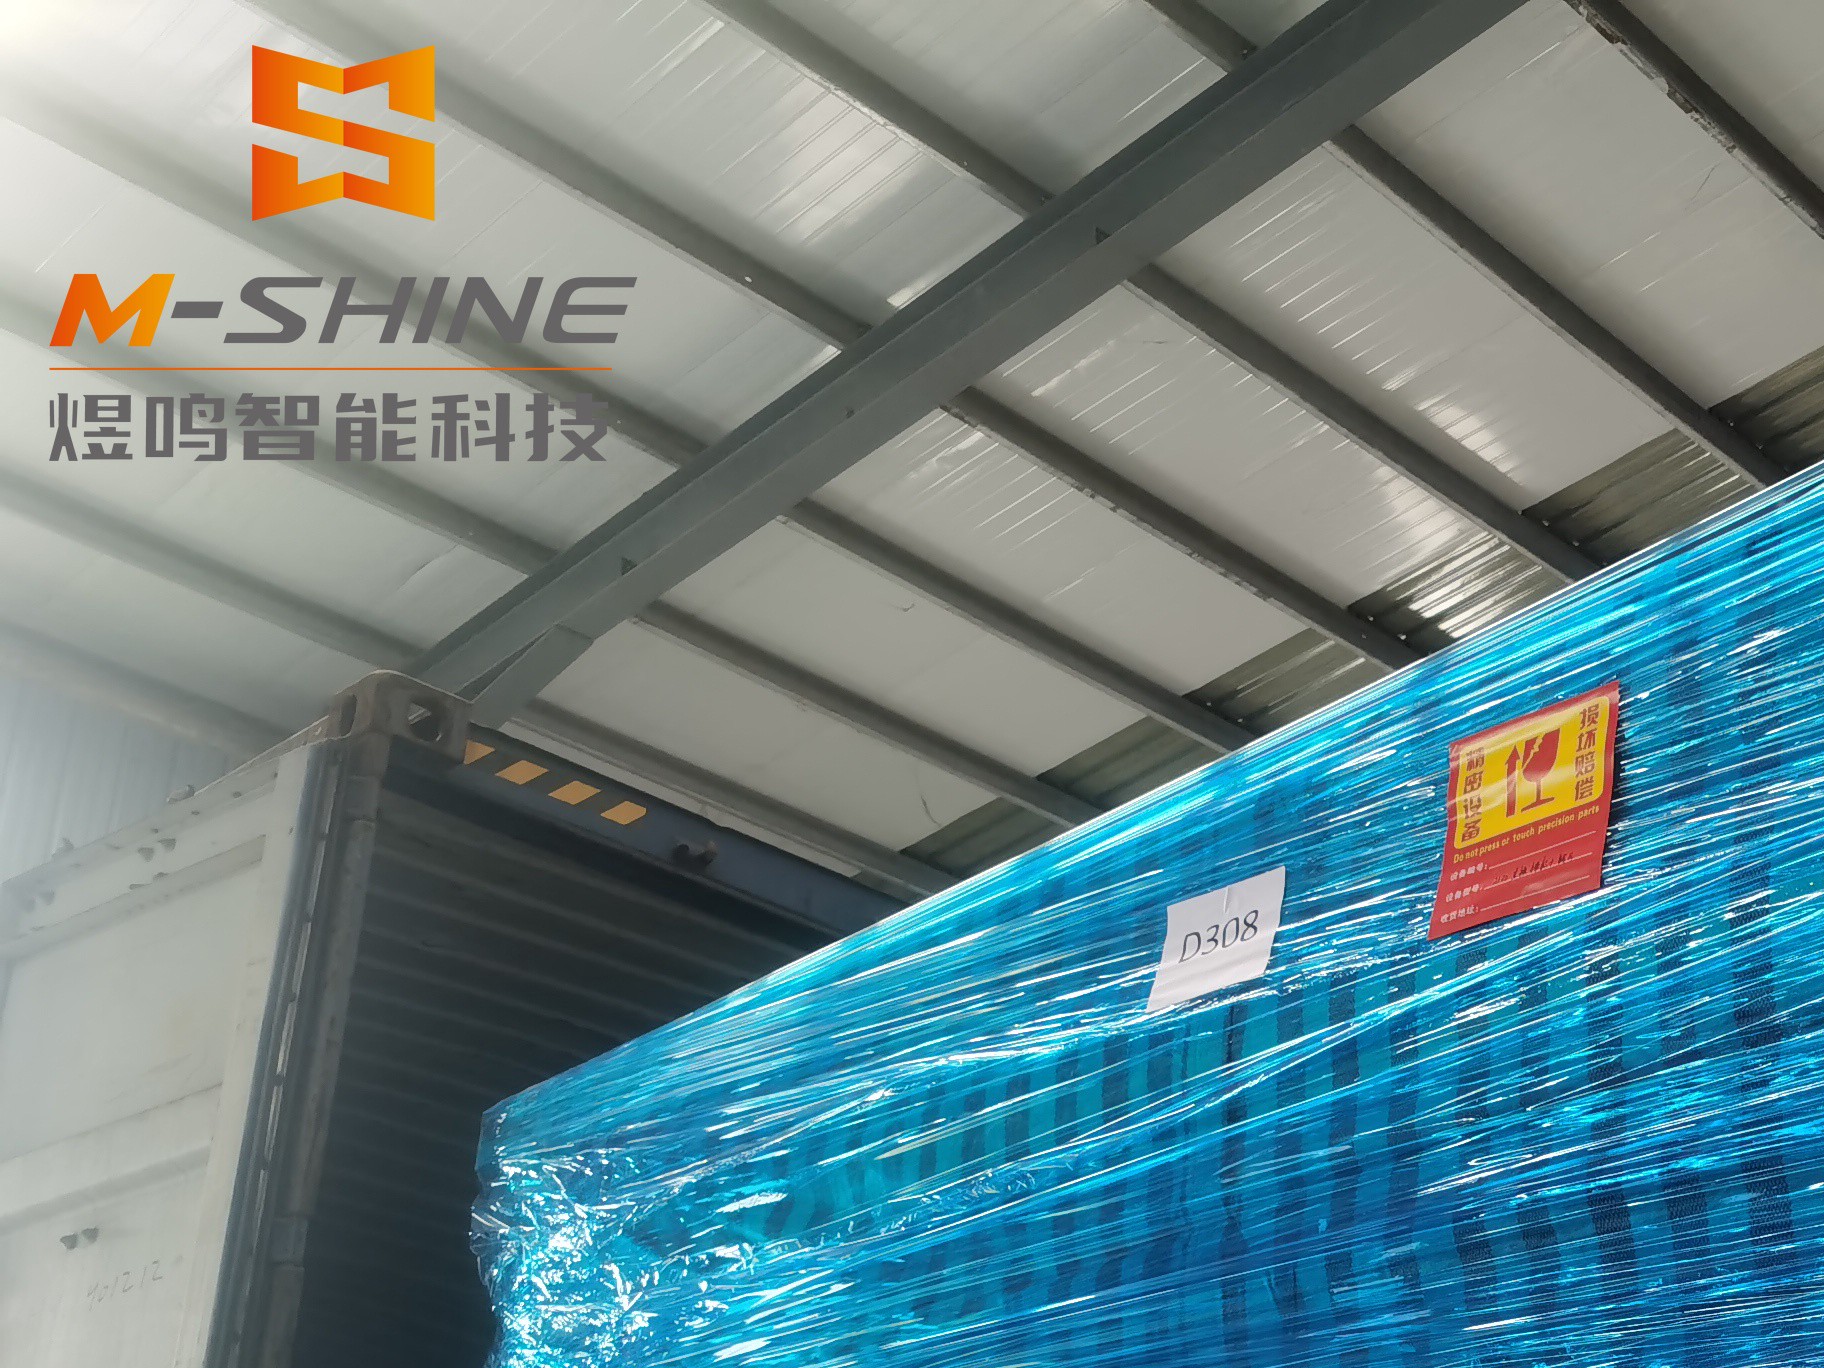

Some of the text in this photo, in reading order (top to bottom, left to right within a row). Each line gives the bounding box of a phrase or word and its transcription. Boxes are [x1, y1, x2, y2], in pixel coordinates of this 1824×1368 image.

[1574, 703, 1600, 802] 损坏赔偿
[1461, 746, 1485, 843] 精密设备
[1453, 805, 1600, 864] Do not press or touch precision parts
[1178, 909, 1259, 964] D308
